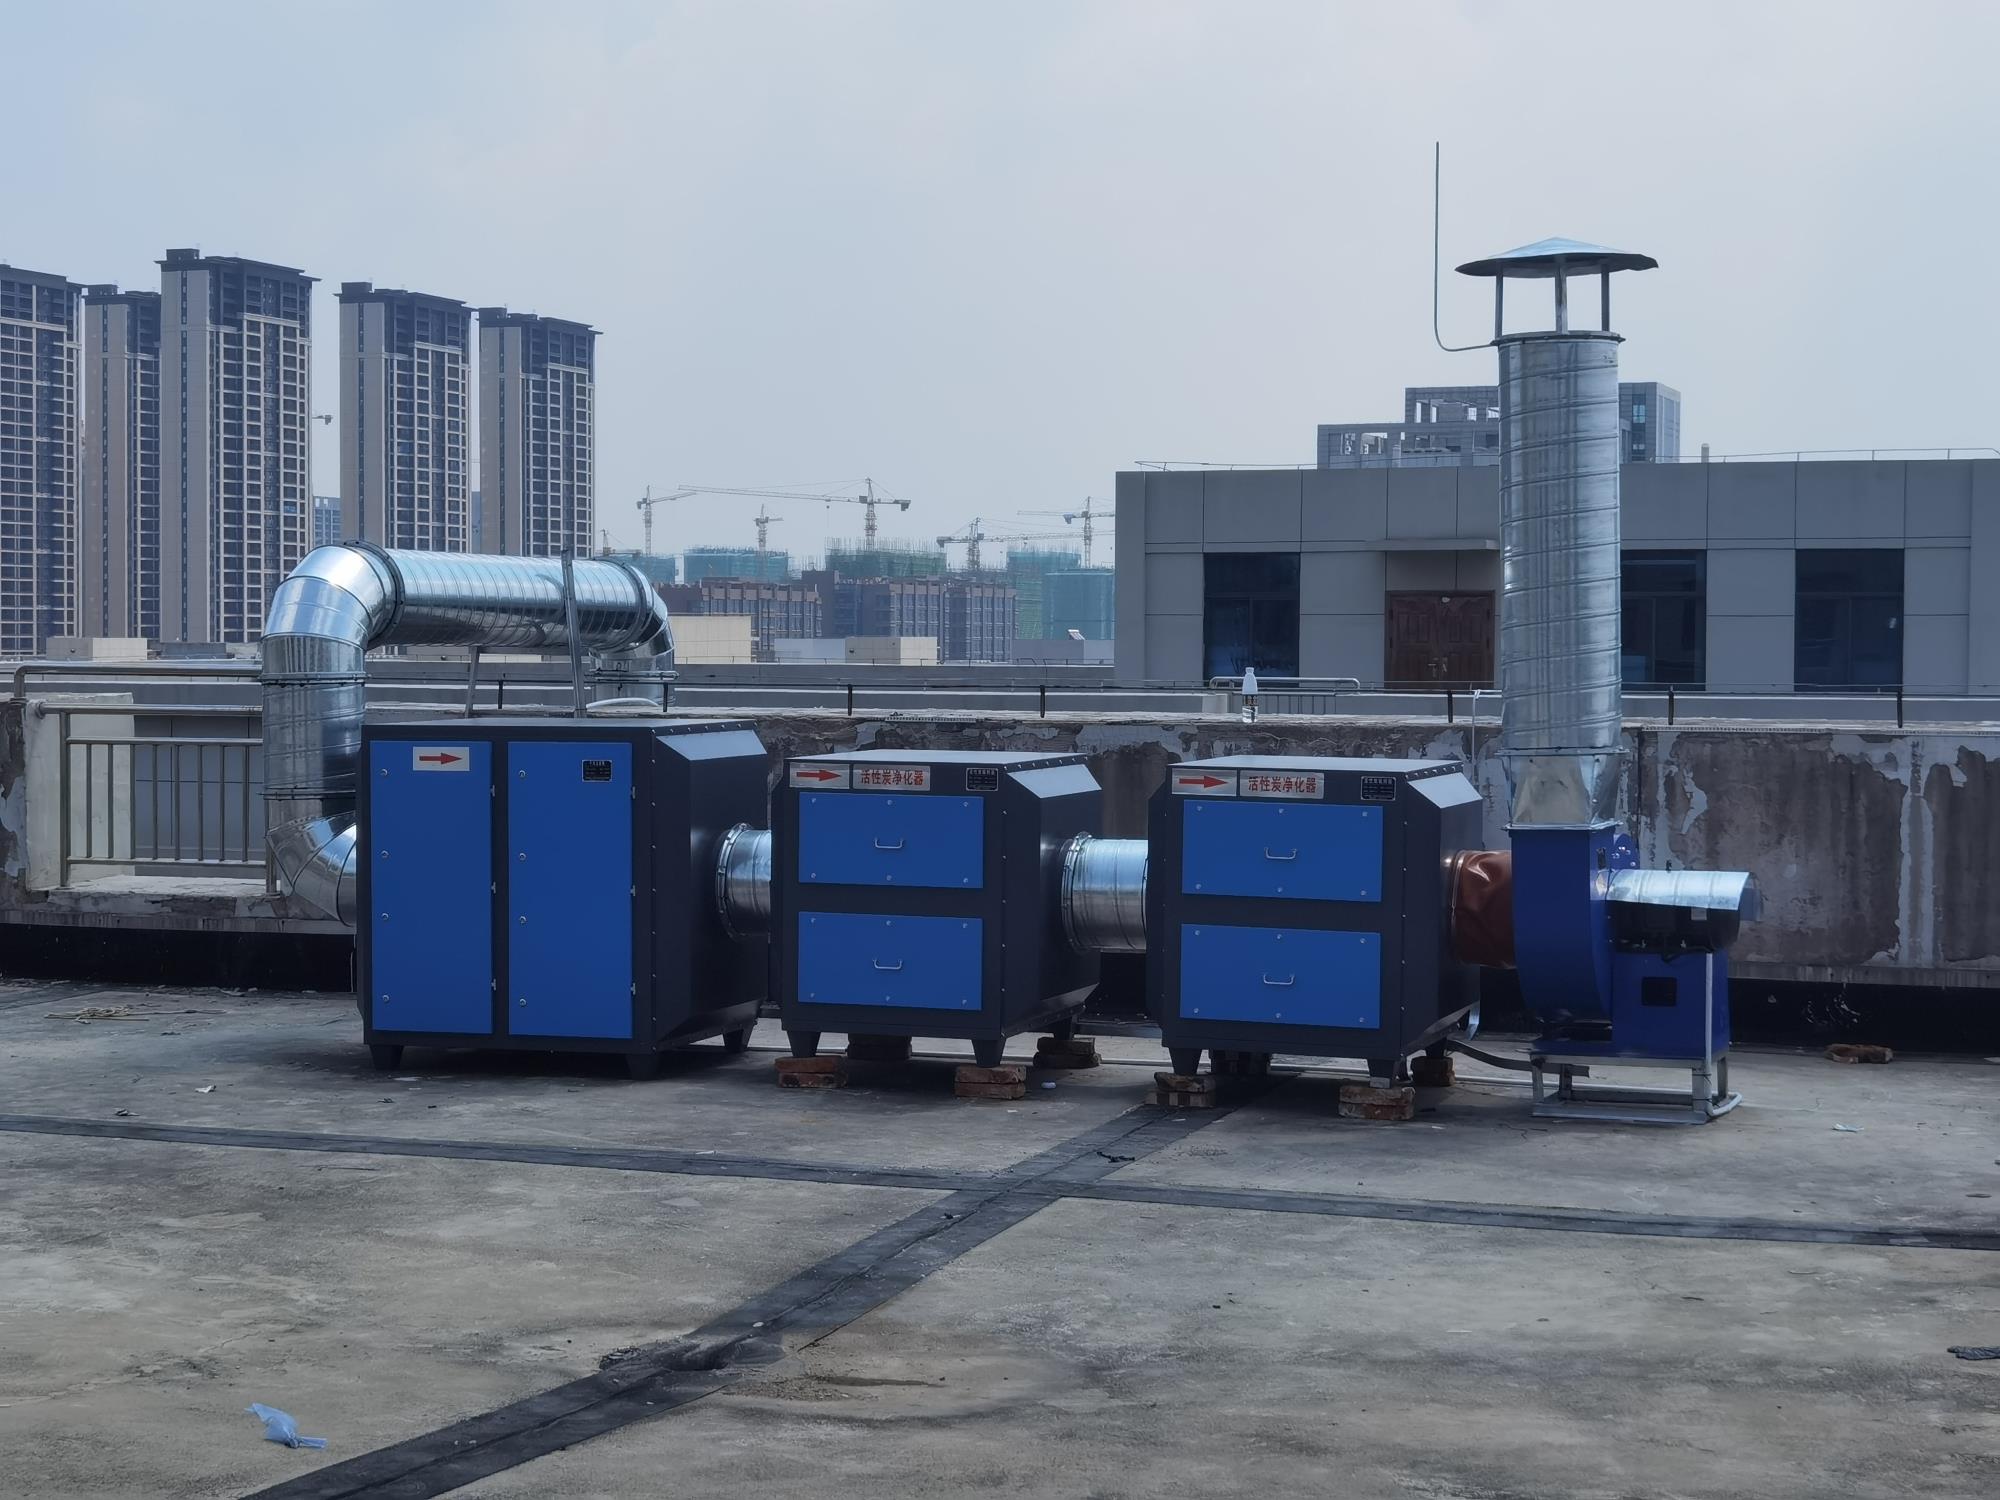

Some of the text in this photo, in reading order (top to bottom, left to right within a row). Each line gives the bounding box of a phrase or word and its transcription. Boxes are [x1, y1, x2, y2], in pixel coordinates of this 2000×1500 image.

[860, 768, 924, 786] 活性炭净化器
[1248, 776, 1317, 793] 活性炭净化器
